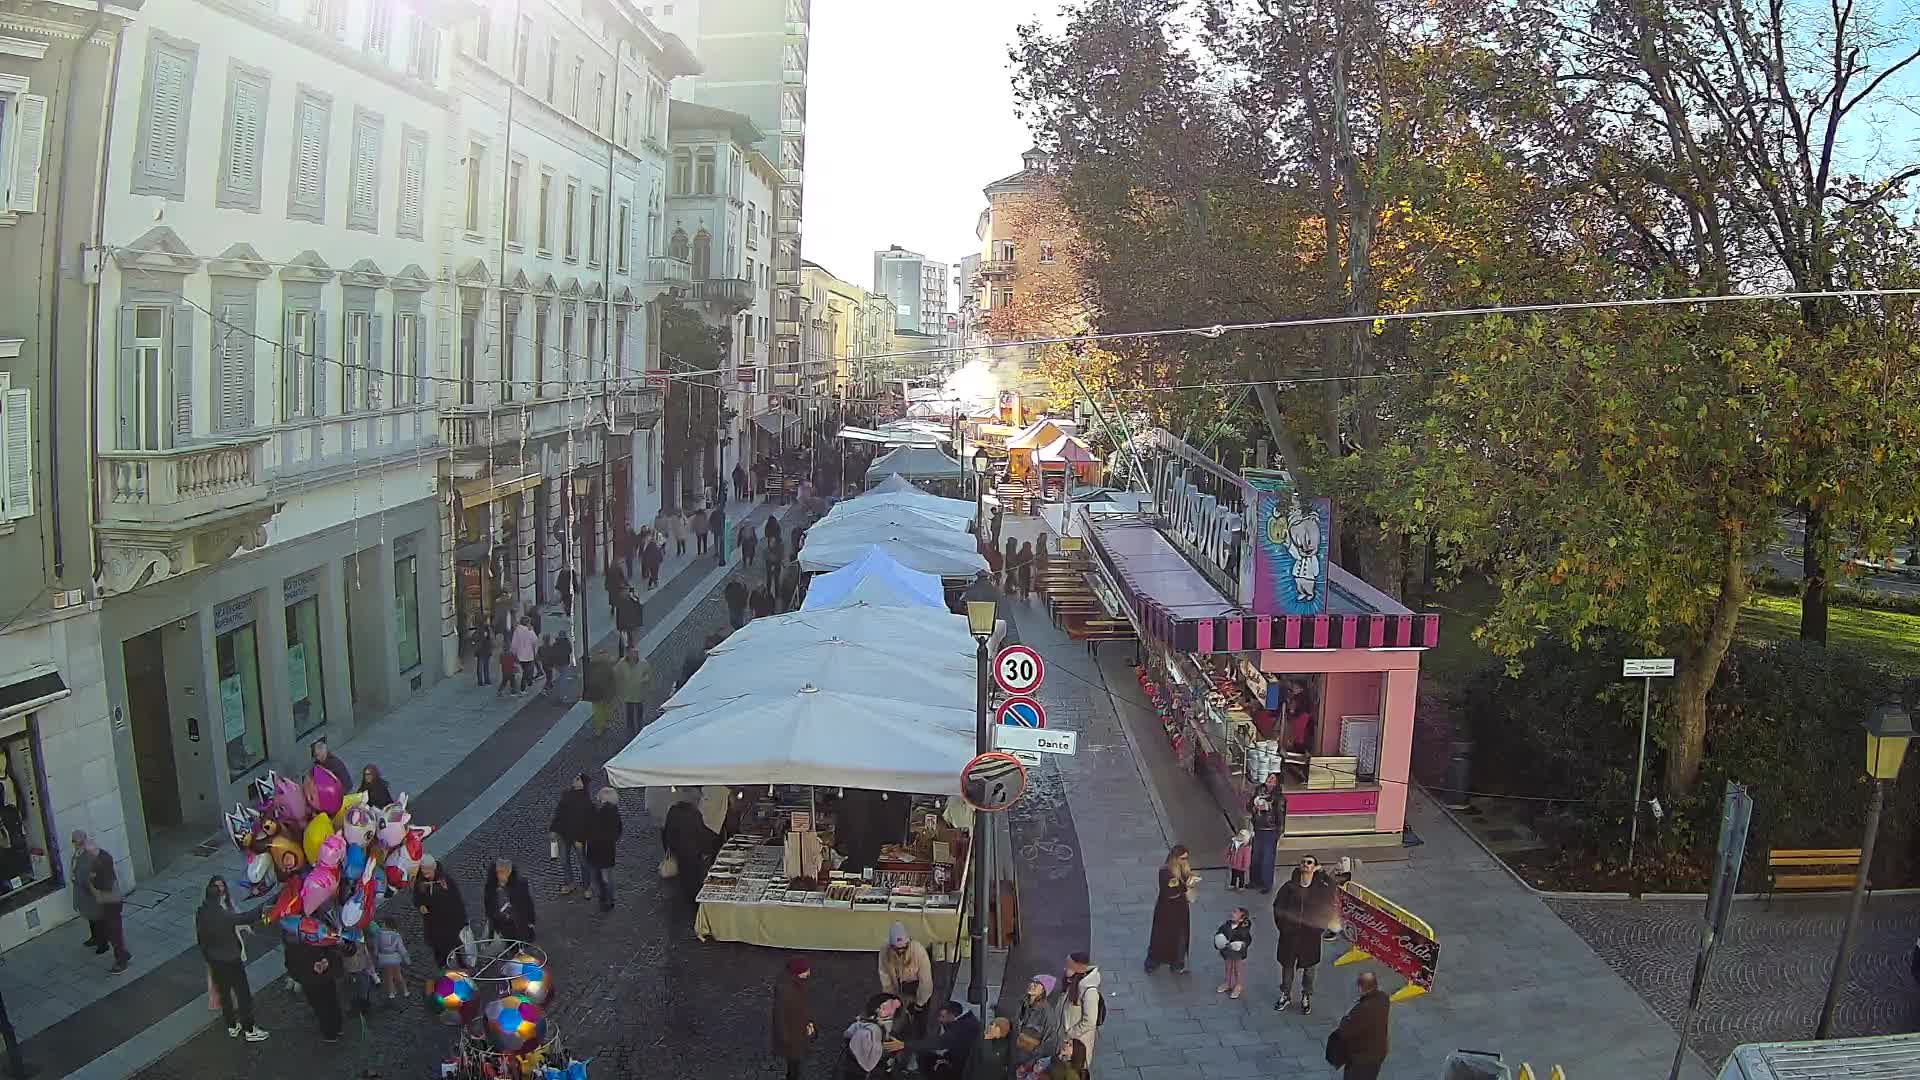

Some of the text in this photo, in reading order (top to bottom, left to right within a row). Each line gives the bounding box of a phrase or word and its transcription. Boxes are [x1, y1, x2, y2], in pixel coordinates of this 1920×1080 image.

[1005, 659, 1033, 681] 30
[1037, 738, 1069, 750] Dante
[1392, 935, 1432, 961] Calde
